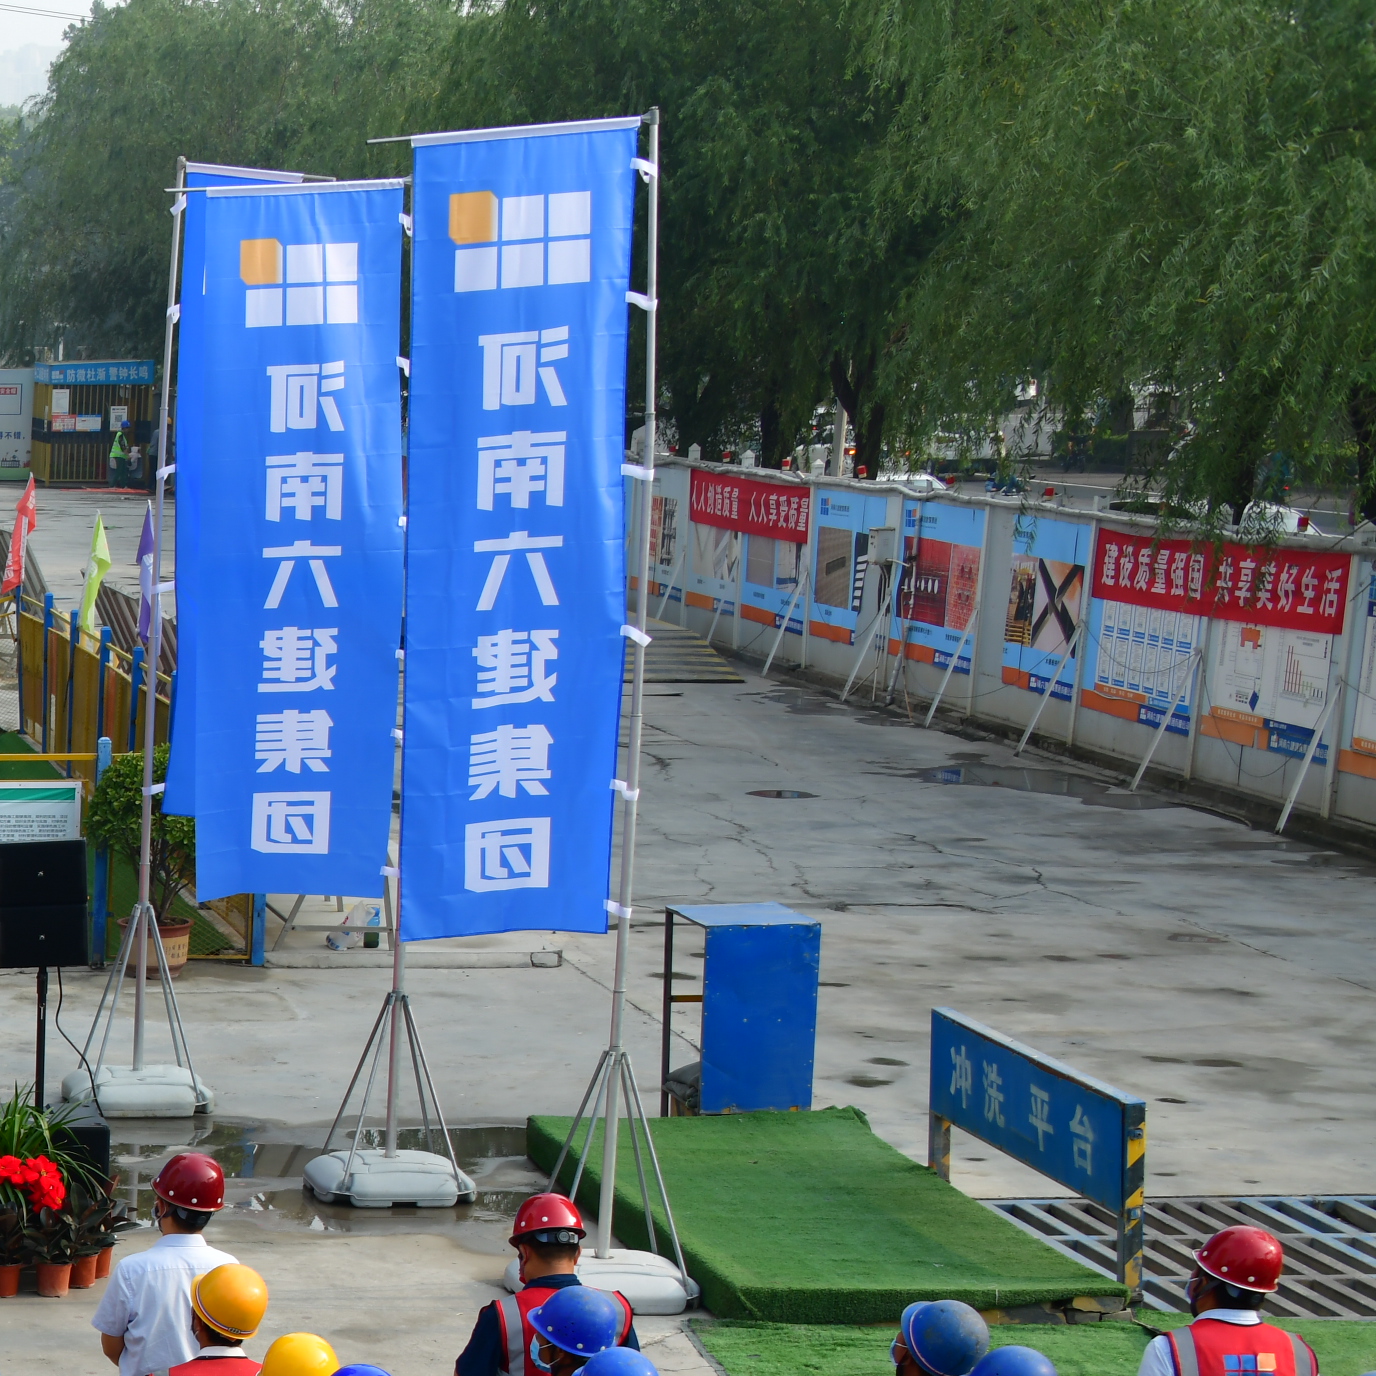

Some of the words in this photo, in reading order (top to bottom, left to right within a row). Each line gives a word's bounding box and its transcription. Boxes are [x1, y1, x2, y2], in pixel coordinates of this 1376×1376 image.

[691, 480, 739, 520] 人人创造质量
[749, 491, 810, 532] 人人享受质量
[1101, 542, 1205, 600] 建设质量强国
[1214, 556, 1343, 618] 共享美好生活
[949, 1045, 1095, 1176] 冲洗平台
